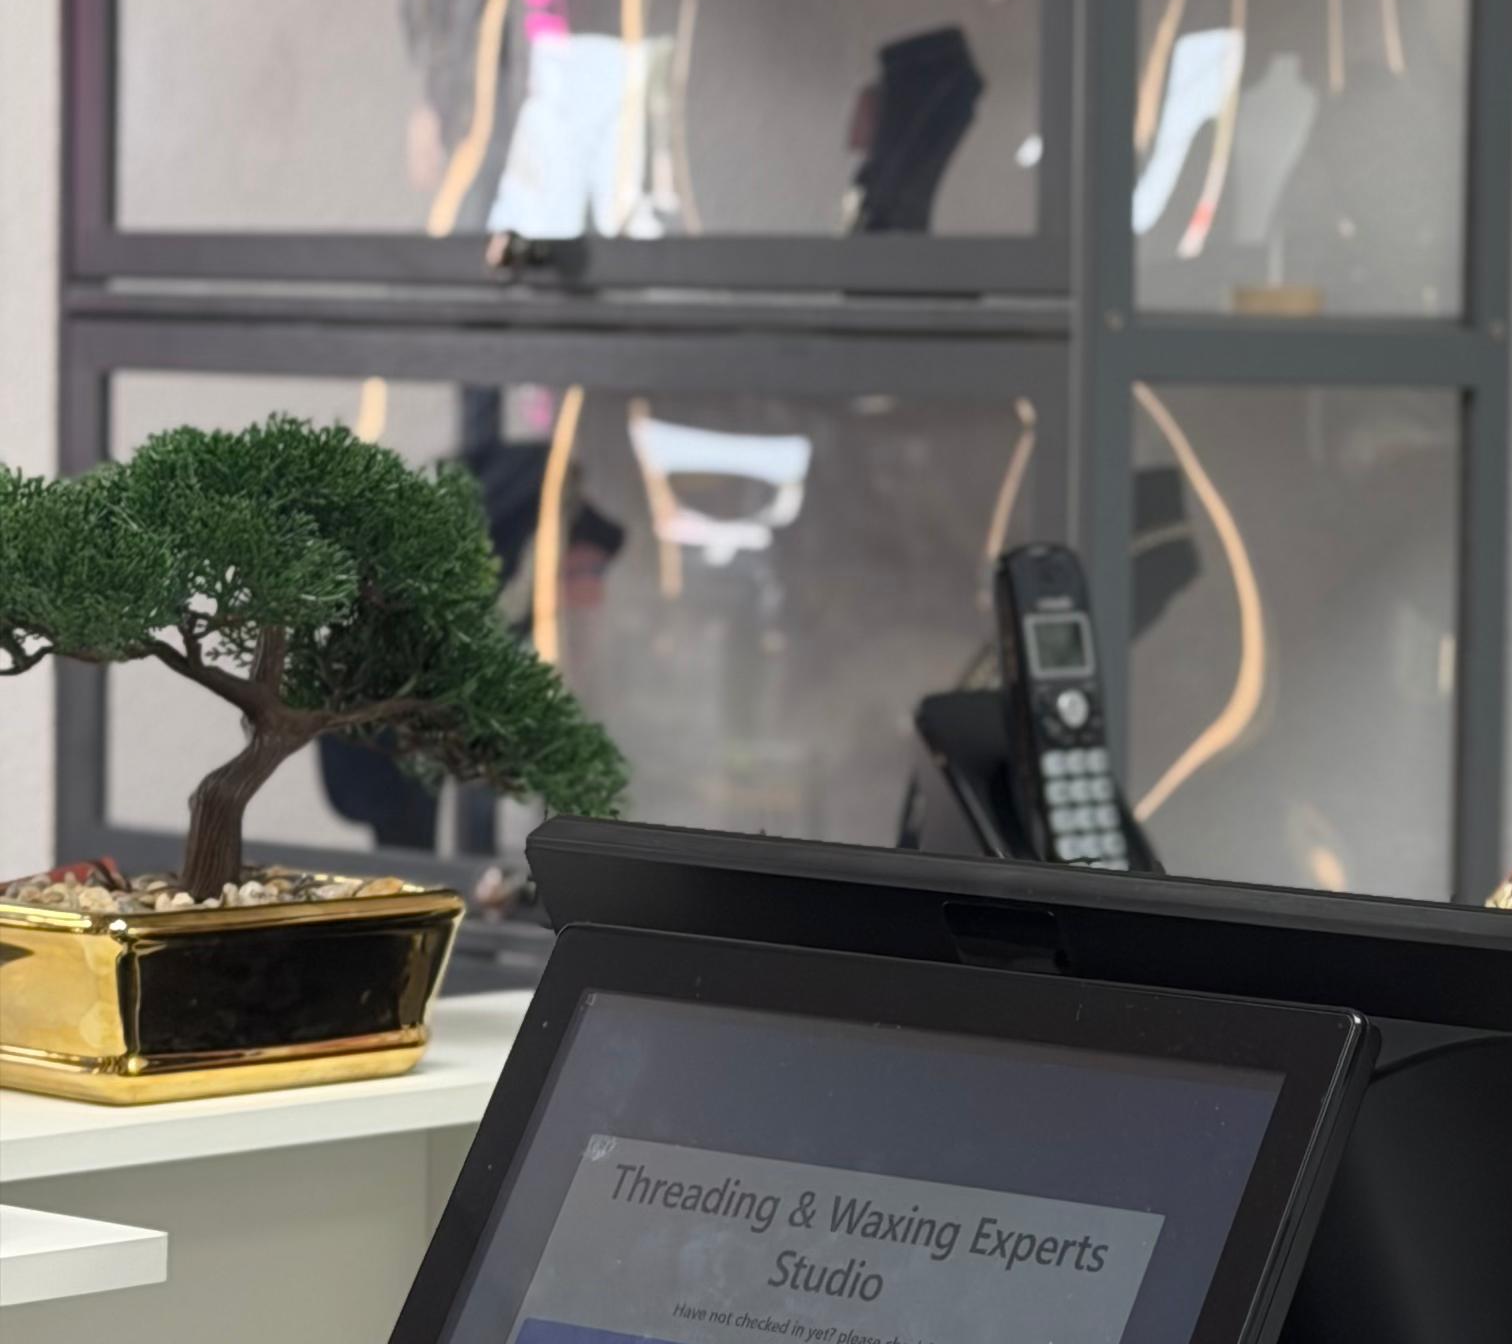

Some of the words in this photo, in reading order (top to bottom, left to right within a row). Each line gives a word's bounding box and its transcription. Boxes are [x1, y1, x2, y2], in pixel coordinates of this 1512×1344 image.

[609, 1163, 780, 1232] Threading
[788, 1191, 816, 1229] &
[830, 1194, 961, 1260] Waxing
[969, 1216, 1109, 1274] Experts
[767, 1249, 884, 1304] Studio
[672, 1304, 705, 1323] Have
[709, 1309, 733, 1326] not
[734, 1311, 791, 1335] checked
[791, 1323, 804, 1338] in
[804, 1326, 836, 1344] yet?
